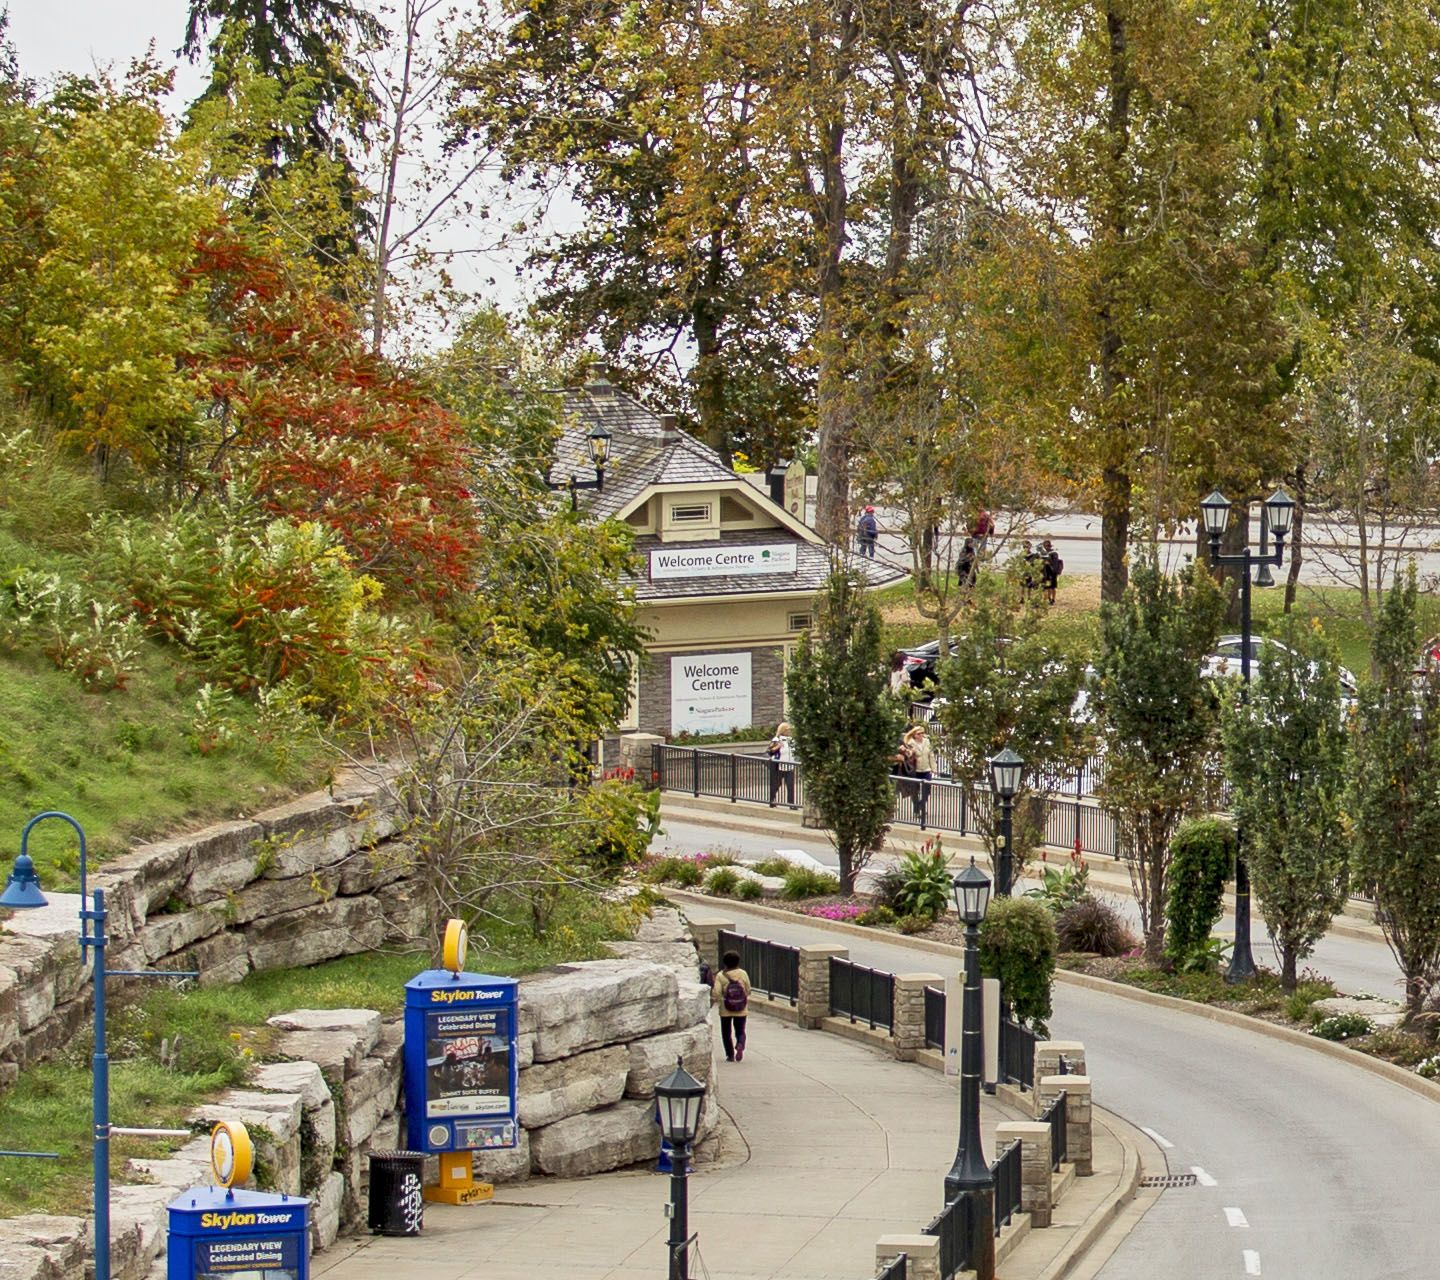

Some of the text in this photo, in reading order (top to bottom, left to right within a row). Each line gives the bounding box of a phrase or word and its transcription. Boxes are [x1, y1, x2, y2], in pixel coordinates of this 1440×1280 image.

[658, 552, 755, 568] Welcome Centre
[683, 664, 739, 678] Welcome
[691, 679, 732, 691] Centre
[431, 990, 504, 1003] Skylon Tower
[438, 1013, 497, 1023] LEGENDARY VIEW
[438, 1021, 497, 1031] Celebrated Dining
[201, 1212, 292, 1229] Skylon Tower
[209, 1241, 282, 1253] LEGENDARY VIEW
[209, 1251, 283, 1263] Celebrated Dining
